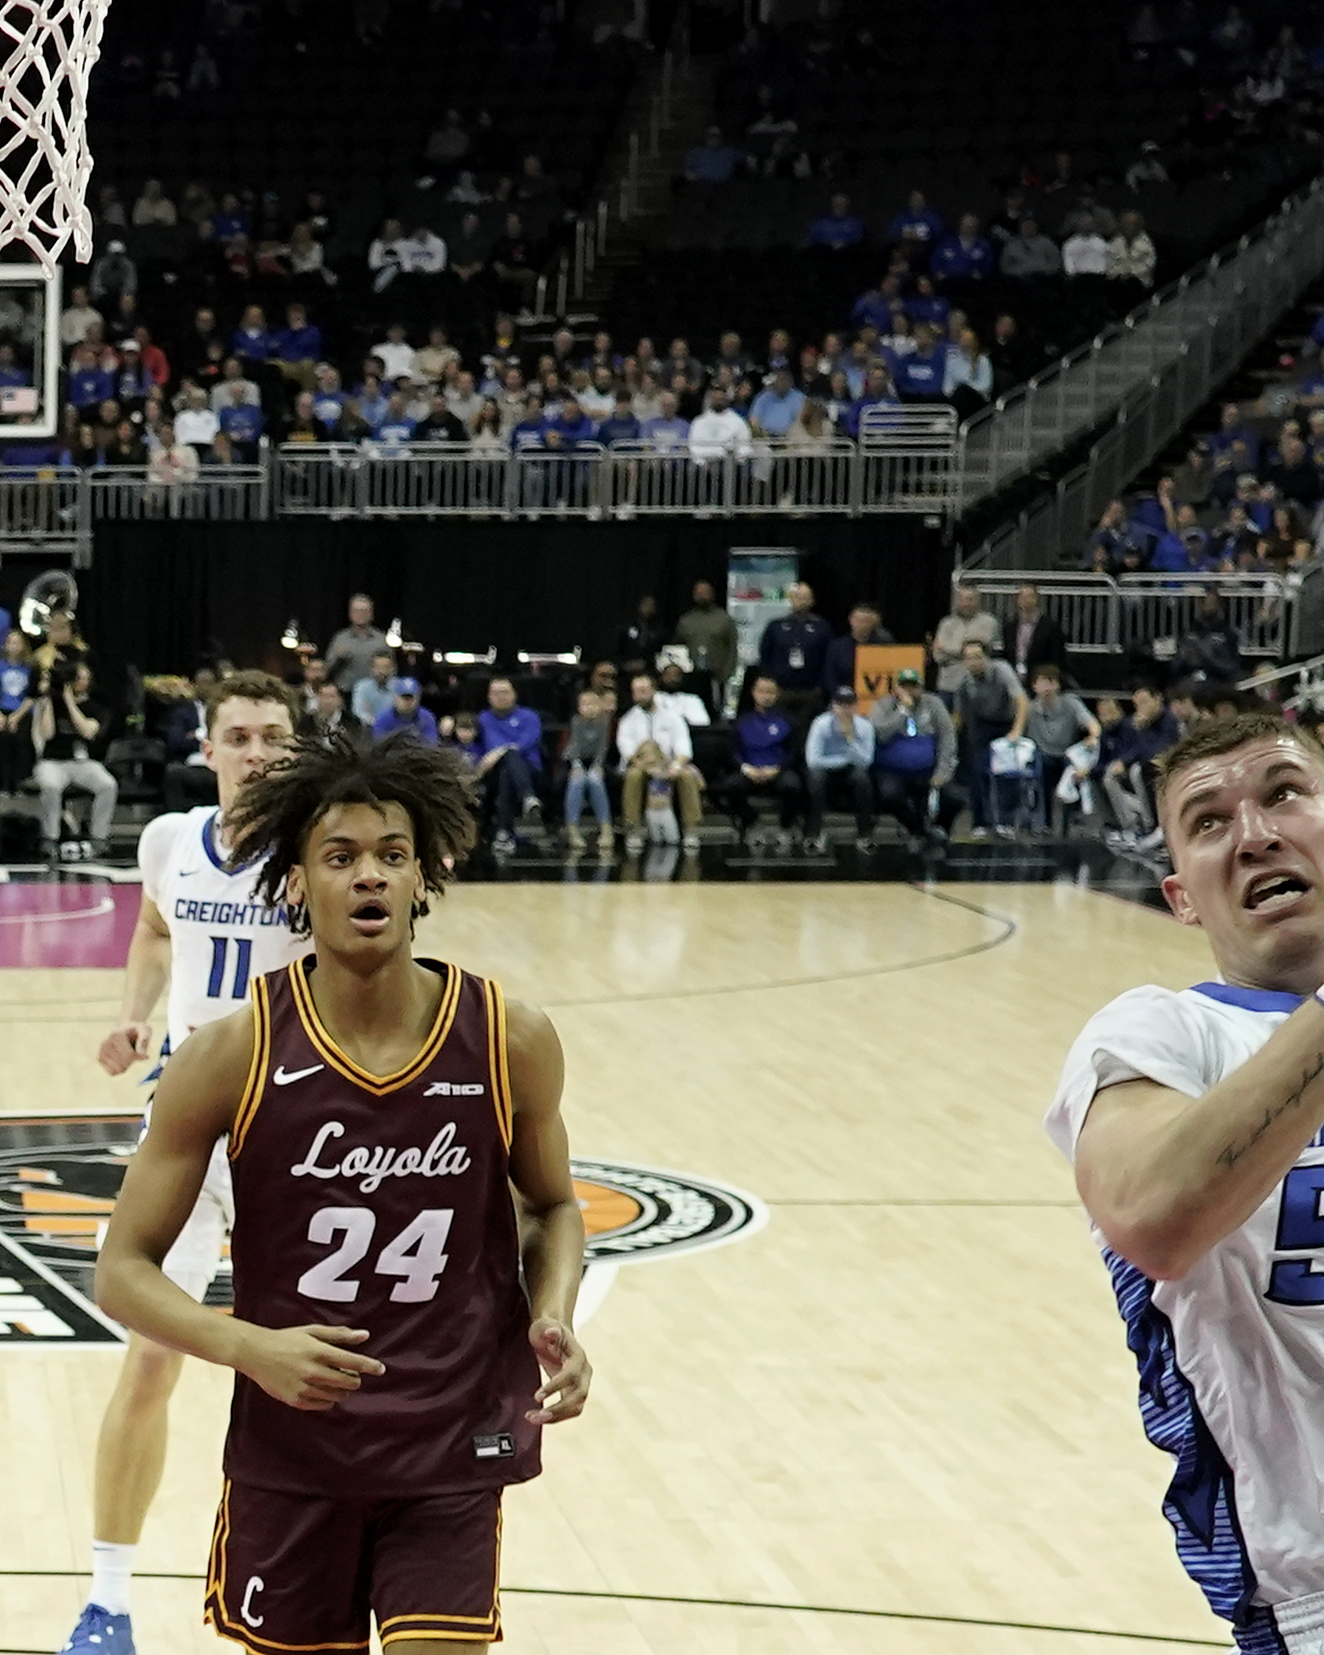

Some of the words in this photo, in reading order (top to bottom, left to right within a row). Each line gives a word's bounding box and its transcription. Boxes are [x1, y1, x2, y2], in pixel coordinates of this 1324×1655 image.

[207, 935, 253, 999] 11
[423, 1082, 485, 1097] A10
[290, 1121, 472, 1194] Loyola
[297, 1206, 454, 1303] 24
